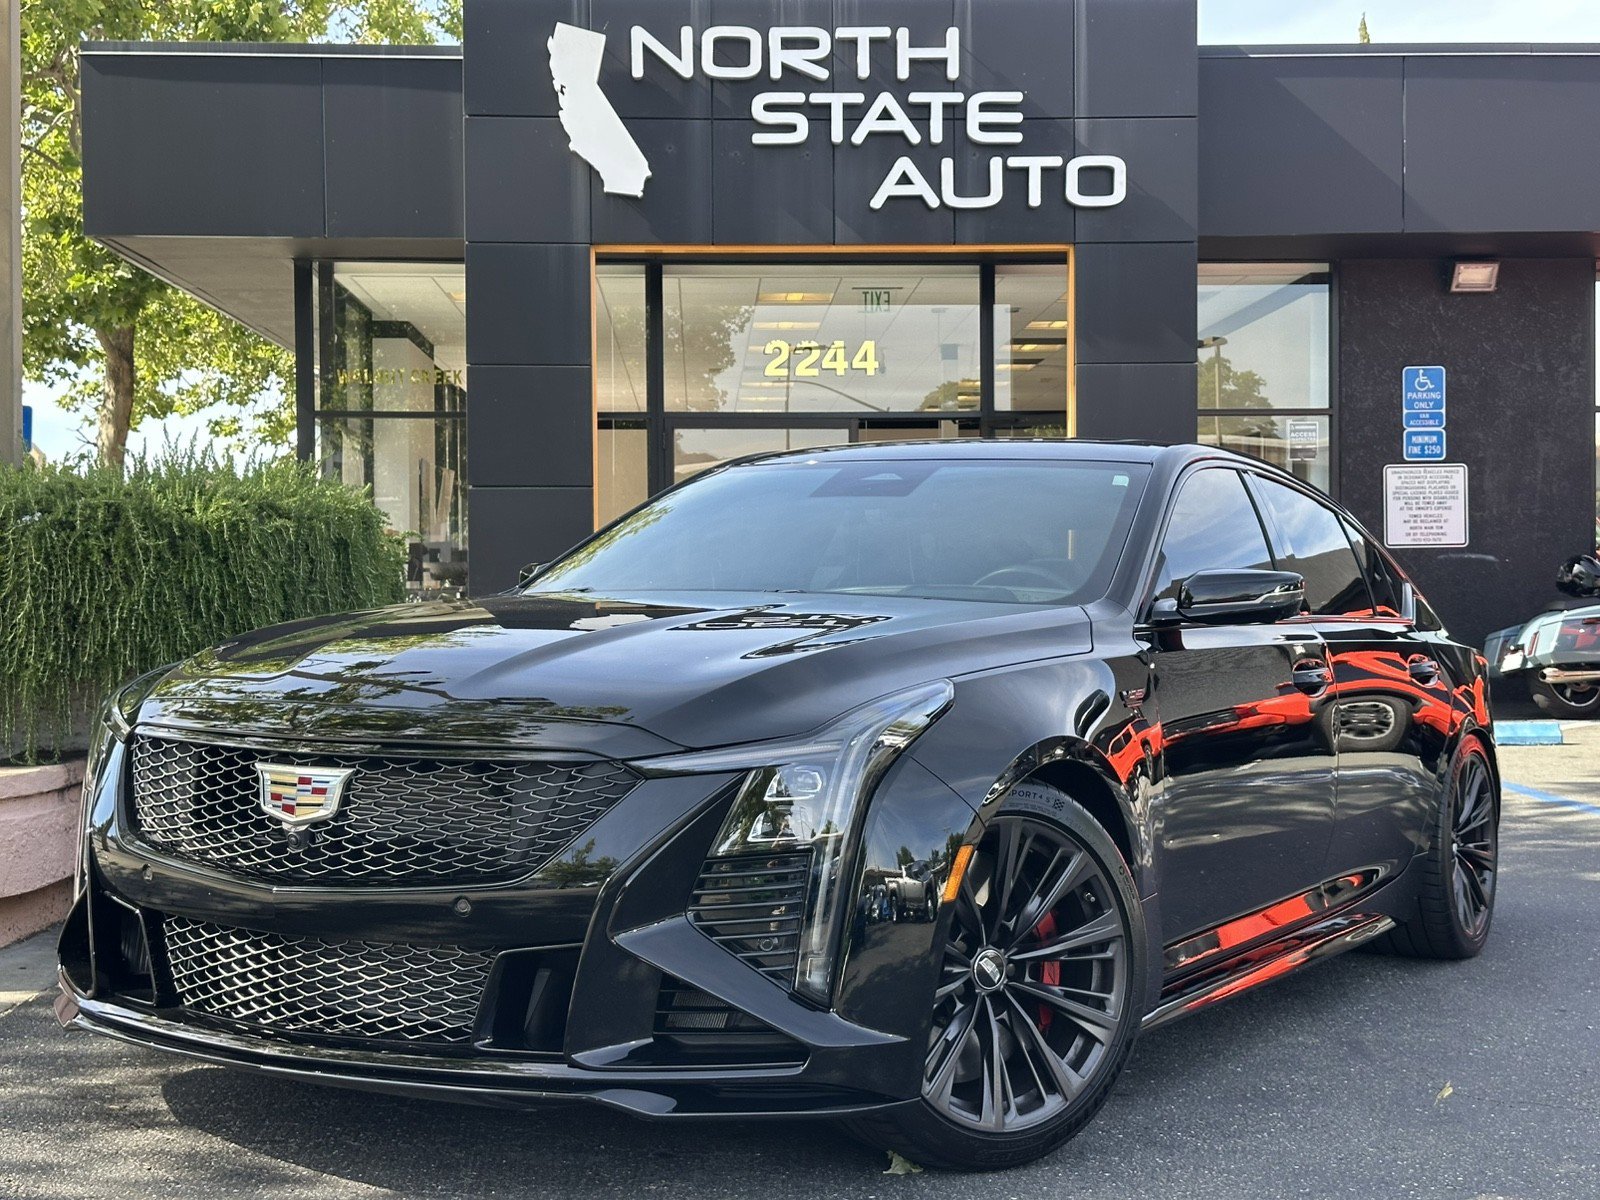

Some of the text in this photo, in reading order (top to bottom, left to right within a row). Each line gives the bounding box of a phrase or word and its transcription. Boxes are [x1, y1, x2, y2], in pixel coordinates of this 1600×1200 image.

[630, 25, 961, 81] NORTH
[751, 91, 1024, 146] STATE
[869, 155, 1127, 210] AUTO
[763, 339, 879, 376] 2244
[410, 369, 463, 385] CREEK
[1407, 391, 1441, 400] PARKING
[1413, 401, 1434, 409] ONLY
[1411, 435, 1438, 444] MINIMUM
[1408, 445, 1441, 455] FINE $250
[1009, 790, 1037, 799] PORT
